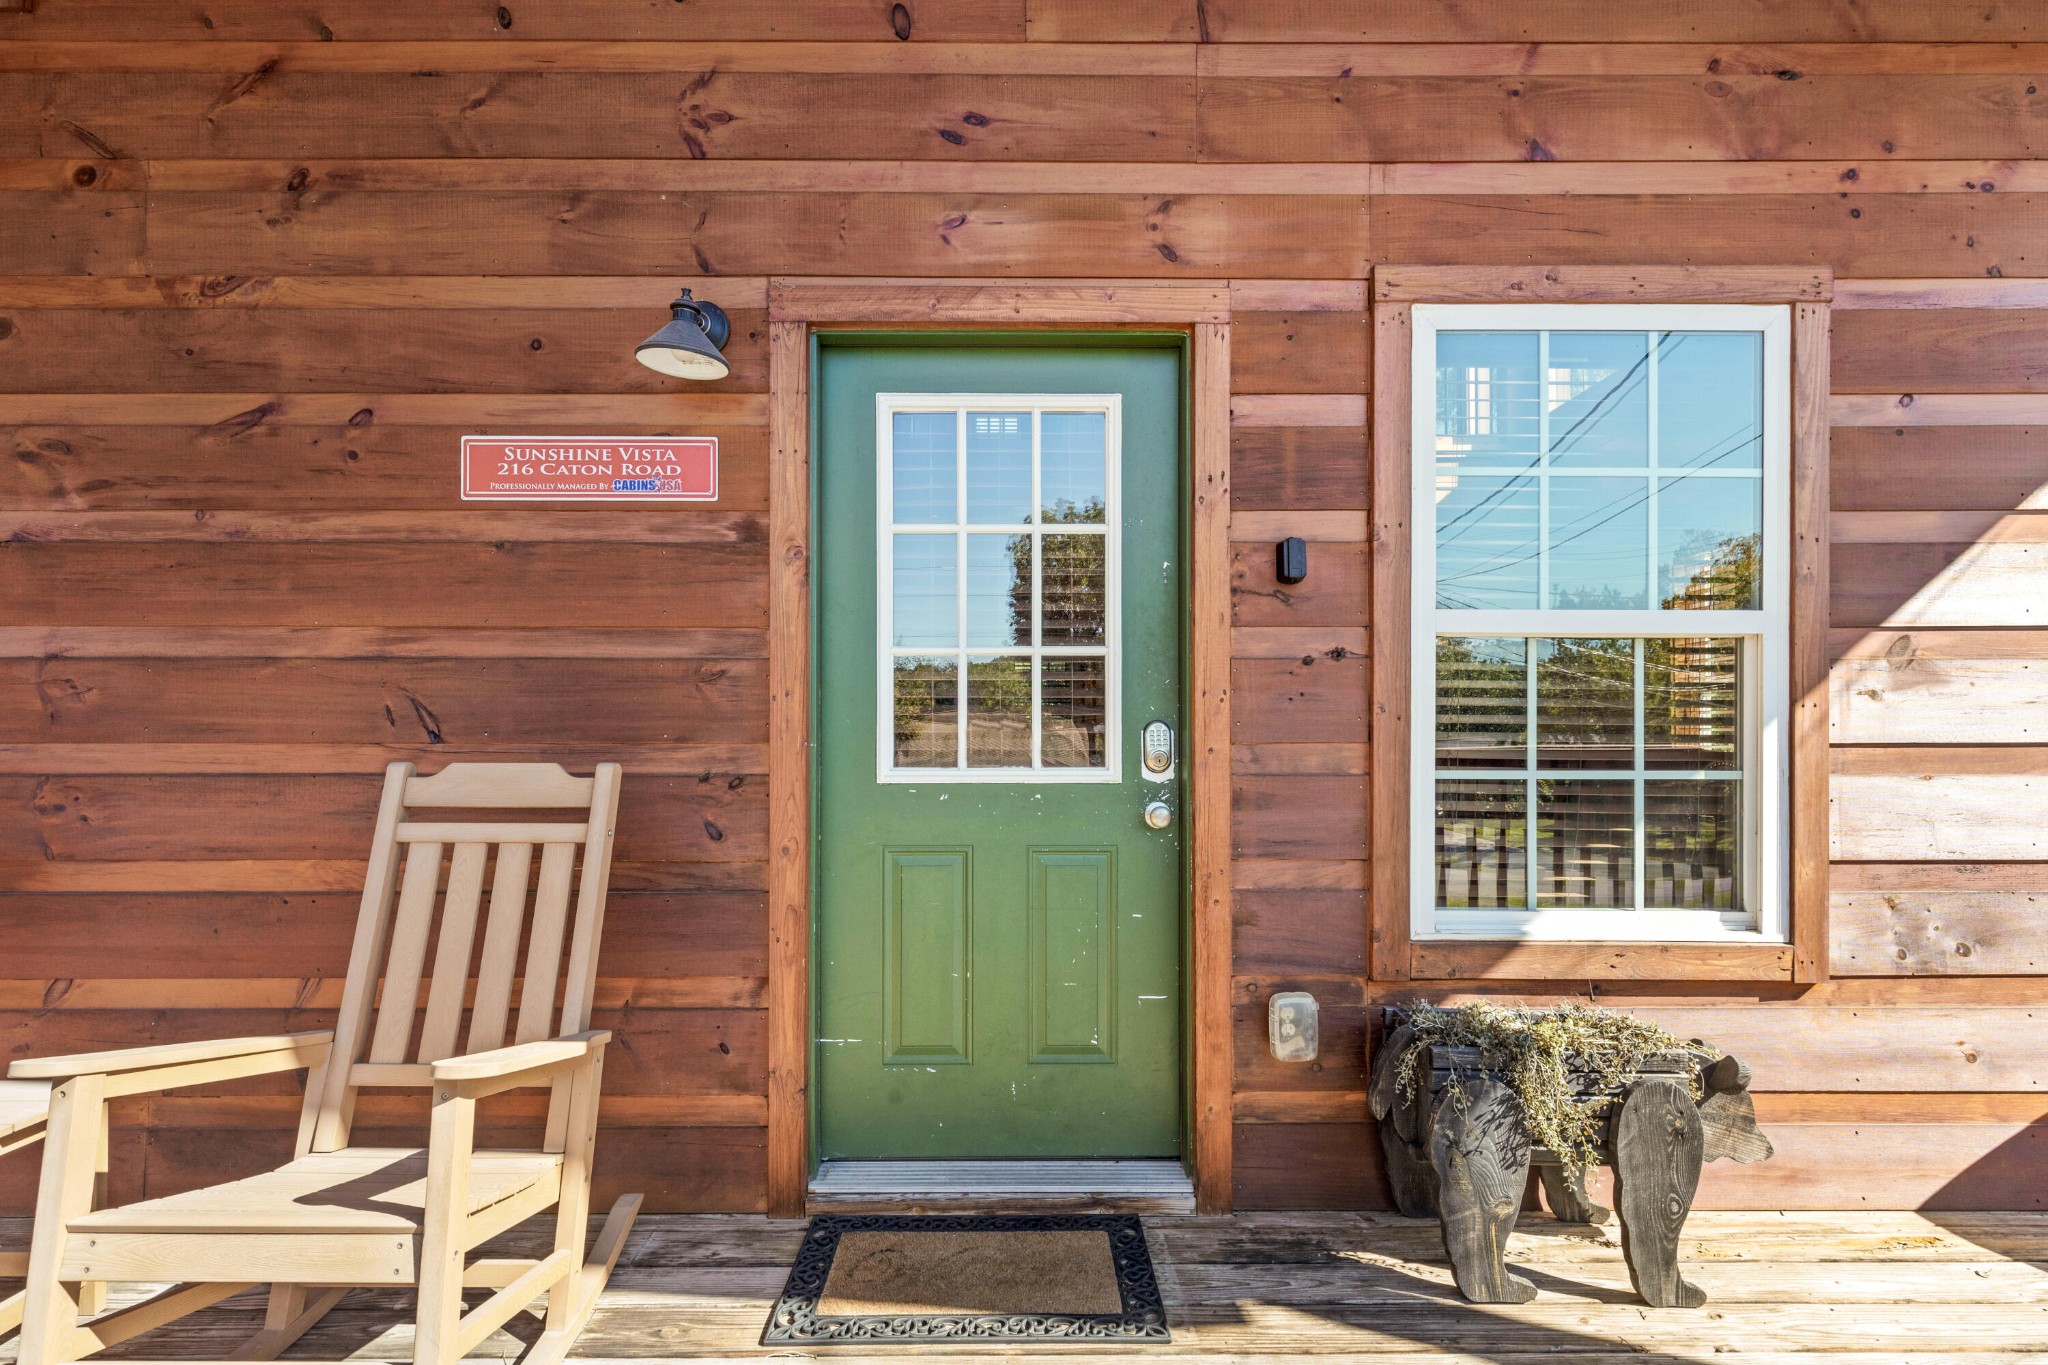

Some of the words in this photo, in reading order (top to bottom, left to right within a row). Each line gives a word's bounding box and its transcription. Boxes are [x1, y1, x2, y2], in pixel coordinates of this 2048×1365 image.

[504, 446, 612, 461] SUNSHINE
[618, 447, 678, 461] VISTA
[497, 462, 534, 475] 216
[540, 463, 613, 476] CATON
[621, 463, 682, 476] ROAD
[490, 482, 555, 490] PROFESSIONALLY
[557, 482, 597, 490] MANAGED
[599, 482, 609, 490] BY
[613, 479, 657, 491] CABINS
[659, 479, 683, 491] USA
